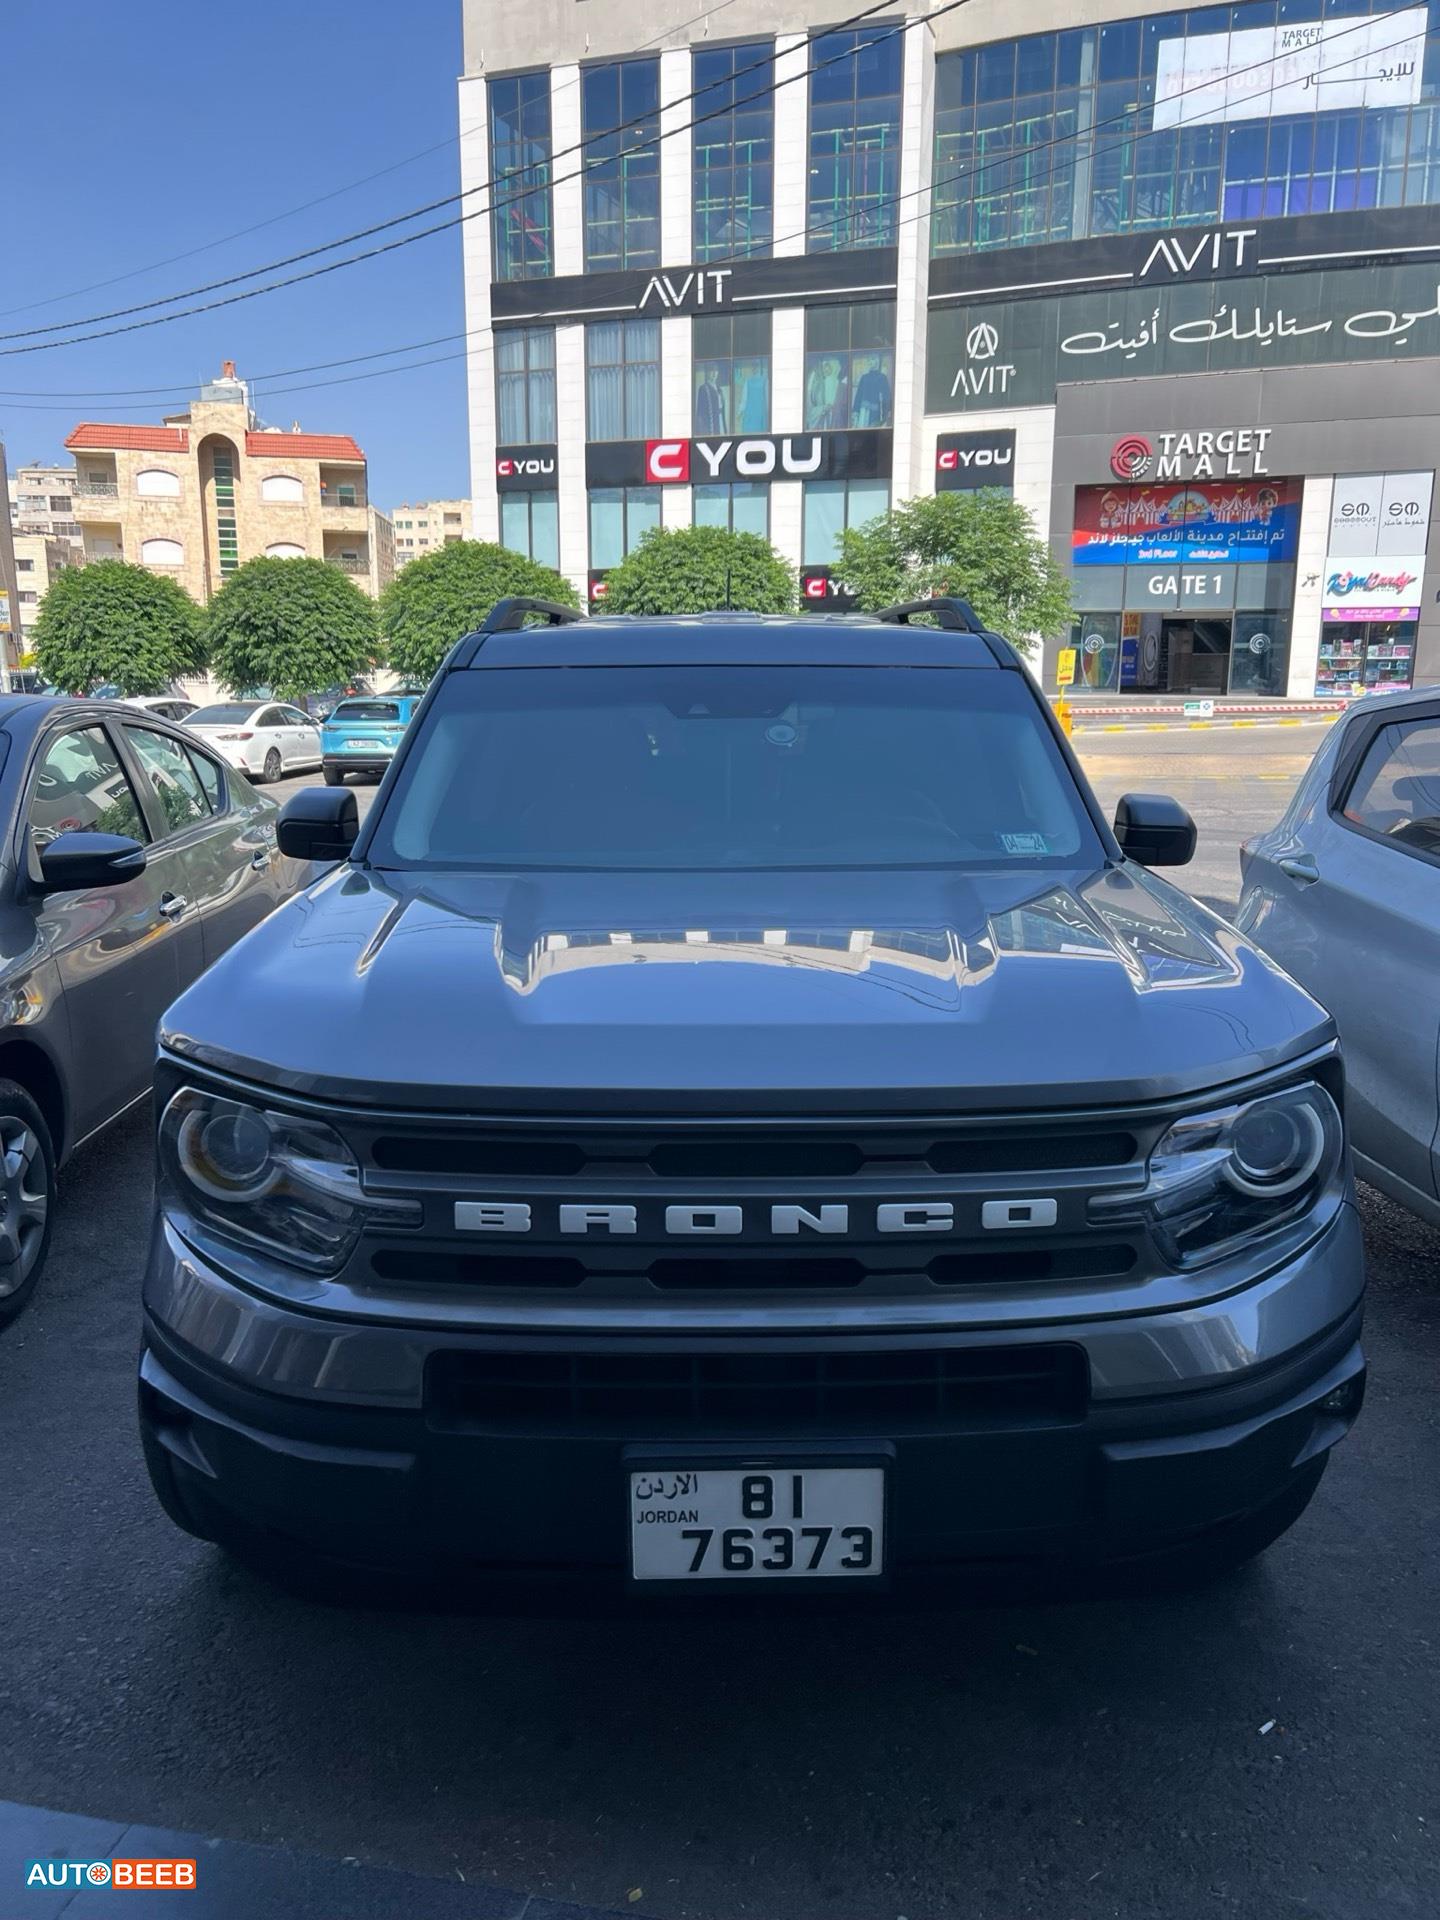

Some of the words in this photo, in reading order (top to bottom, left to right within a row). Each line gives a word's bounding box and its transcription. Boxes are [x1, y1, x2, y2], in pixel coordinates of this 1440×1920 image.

[1282, 28, 1322, 39] TARGET
[1140, 229, 1257, 277] AVIT
[639, 269, 732, 309] AVIT
[1061, 308, 1160, 359] أفيت
[951, 365, 1014, 397] AVIT
[1157, 429, 1272, 456] TARGET
[498, 461, 510, 475] C
[513, 459, 554, 474] YOU
[650, 444, 683, 478] C
[696, 437, 822, 476] YOU
[939, 453, 954, 467] C
[959, 448, 1011, 466] YOU
[1156, 452, 1269, 477] MALL
[1088, 533, 1109, 544] لاند
[1146, 530, 1184, 545] الألعاب
[1187, 530, 1224, 544] مدينة
[1270, 529, 1285, 544] تم
[1148, 575, 1207, 595] GATE
[1213, 575, 1222, 594] 1
[454, 1199, 1058, 1235] BRONCO
[742, 1475, 803, 1519] 81
[637, 1510, 699, 1525] JORDAN
[682, 1526, 873, 1572] 76373
